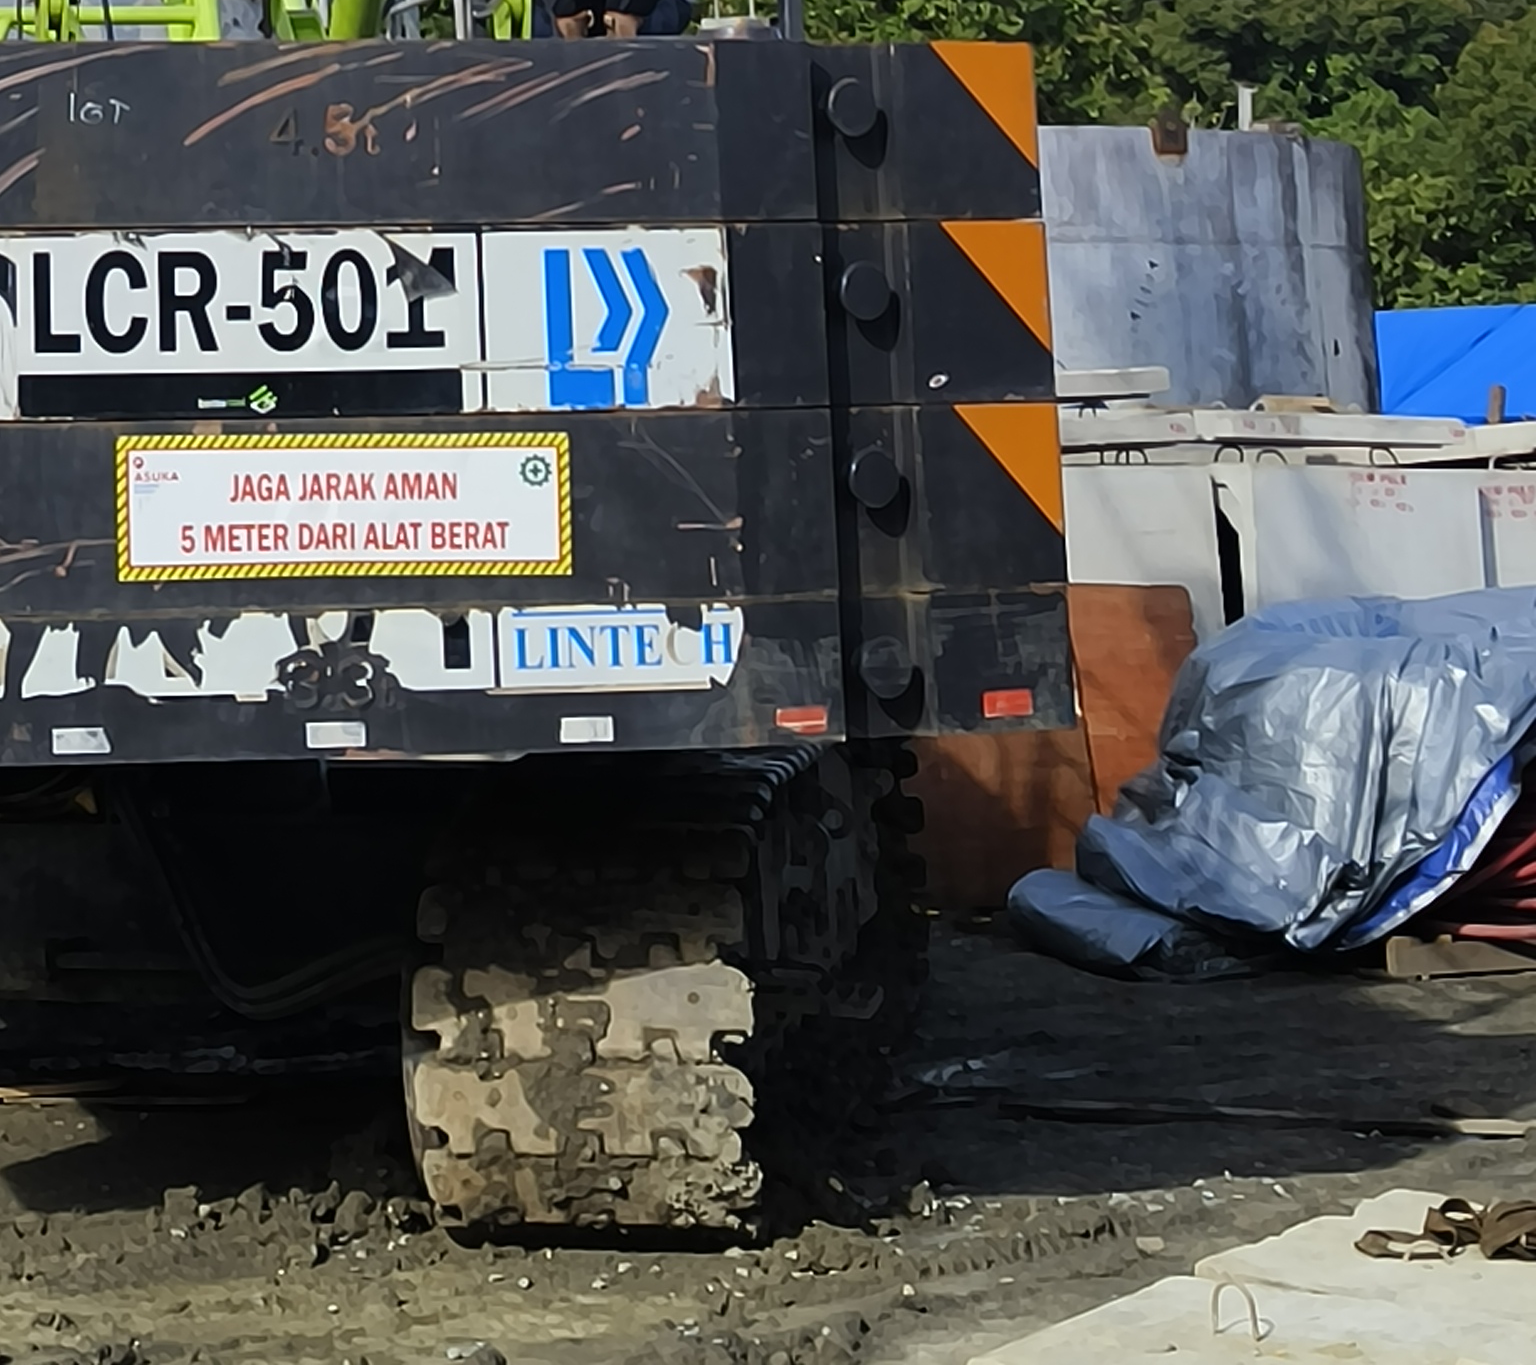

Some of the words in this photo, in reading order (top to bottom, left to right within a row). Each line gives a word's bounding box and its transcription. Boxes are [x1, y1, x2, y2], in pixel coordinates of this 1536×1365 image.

[32, 246, 458, 354] LCR-501
[229, 473, 291, 502] JAGA
[298, 472, 376, 501] JARAK
[383, 471, 457, 501] AMAN
[180, 524, 196, 554] 5
[204, 523, 289, 553] METER
[298, 522, 356, 551] DARI
[363, 521, 422, 550] ALAT
[430, 521, 510, 550] BERAT
